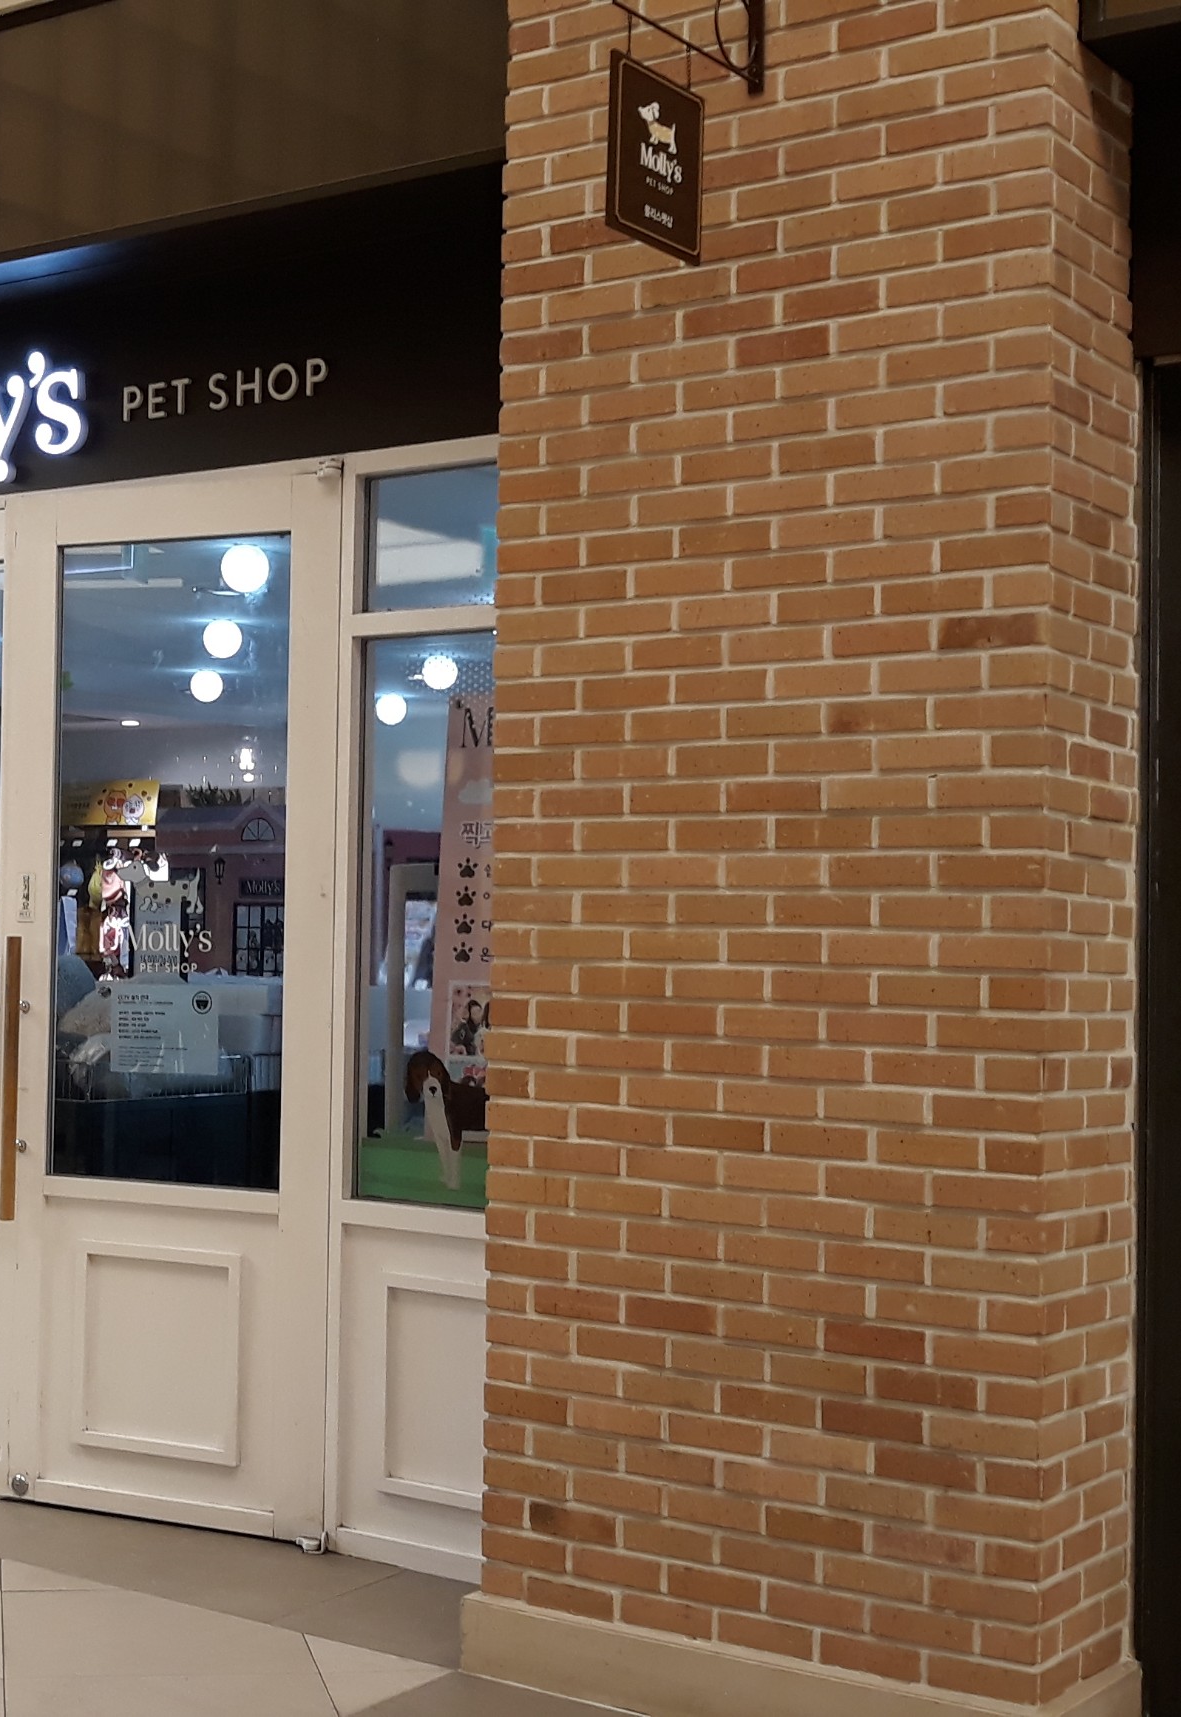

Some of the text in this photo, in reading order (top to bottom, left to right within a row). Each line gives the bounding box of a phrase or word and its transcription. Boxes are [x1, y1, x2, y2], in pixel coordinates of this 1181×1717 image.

[640, 142, 683, 184] Molly's
[645, 175, 674, 196] PET SHOP
[122, 376, 193, 422] PET
[207, 356, 329, 412] SHOP
[128, 923, 213, 958] Molly's
[140, 962, 198, 974] PET SHOP
